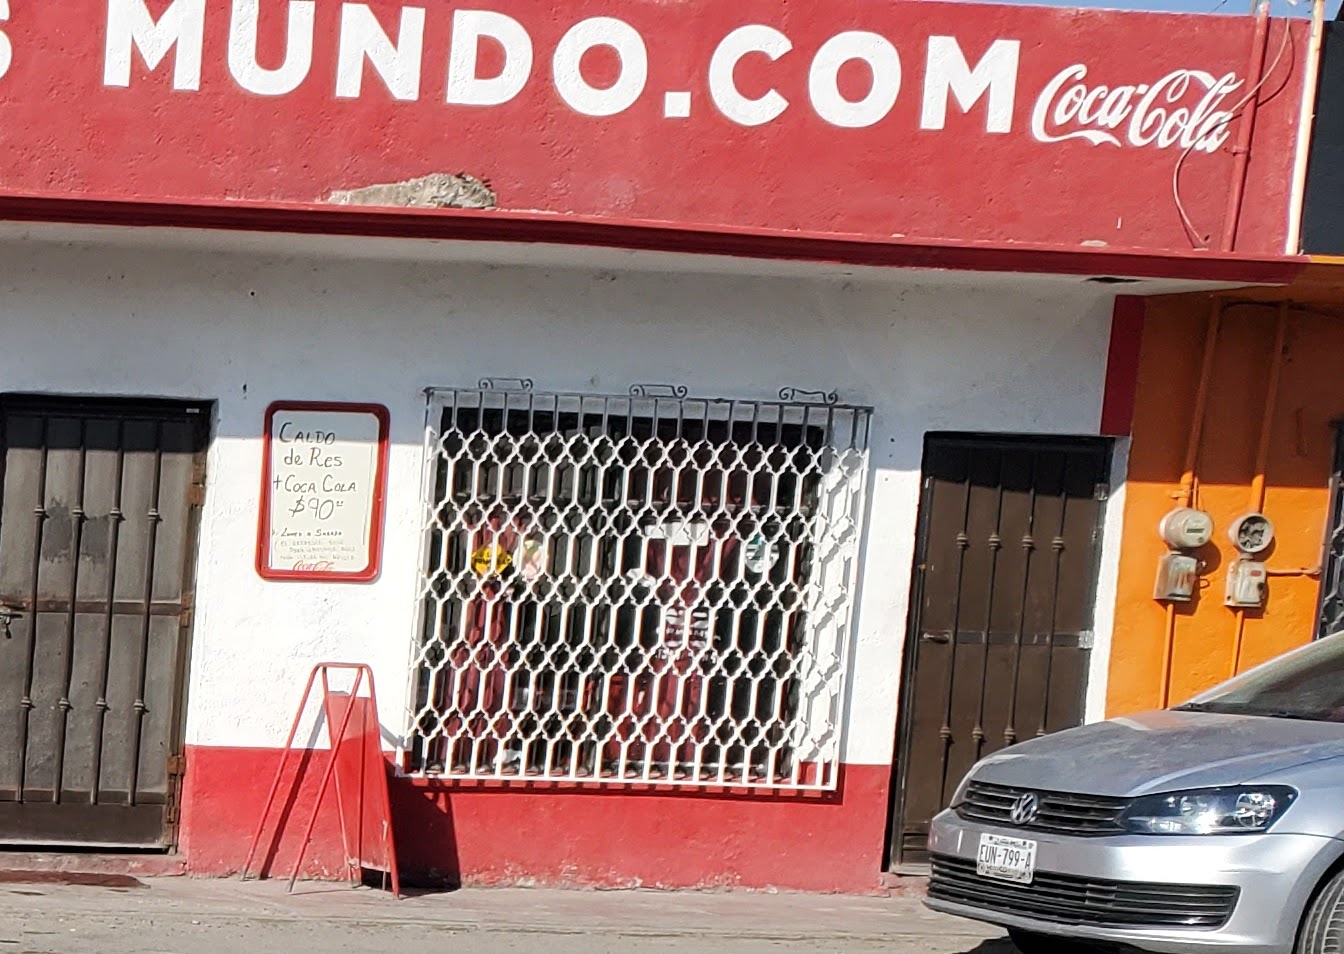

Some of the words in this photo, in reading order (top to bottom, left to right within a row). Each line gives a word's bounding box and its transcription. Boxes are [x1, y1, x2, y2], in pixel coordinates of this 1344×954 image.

[103, 0, 1021, 134] MUNDO.COM
[284, 447, 303, 466] de
[309, 446, 343, 467] Res
[979, 844, 1032, 869] EUN-799-A
